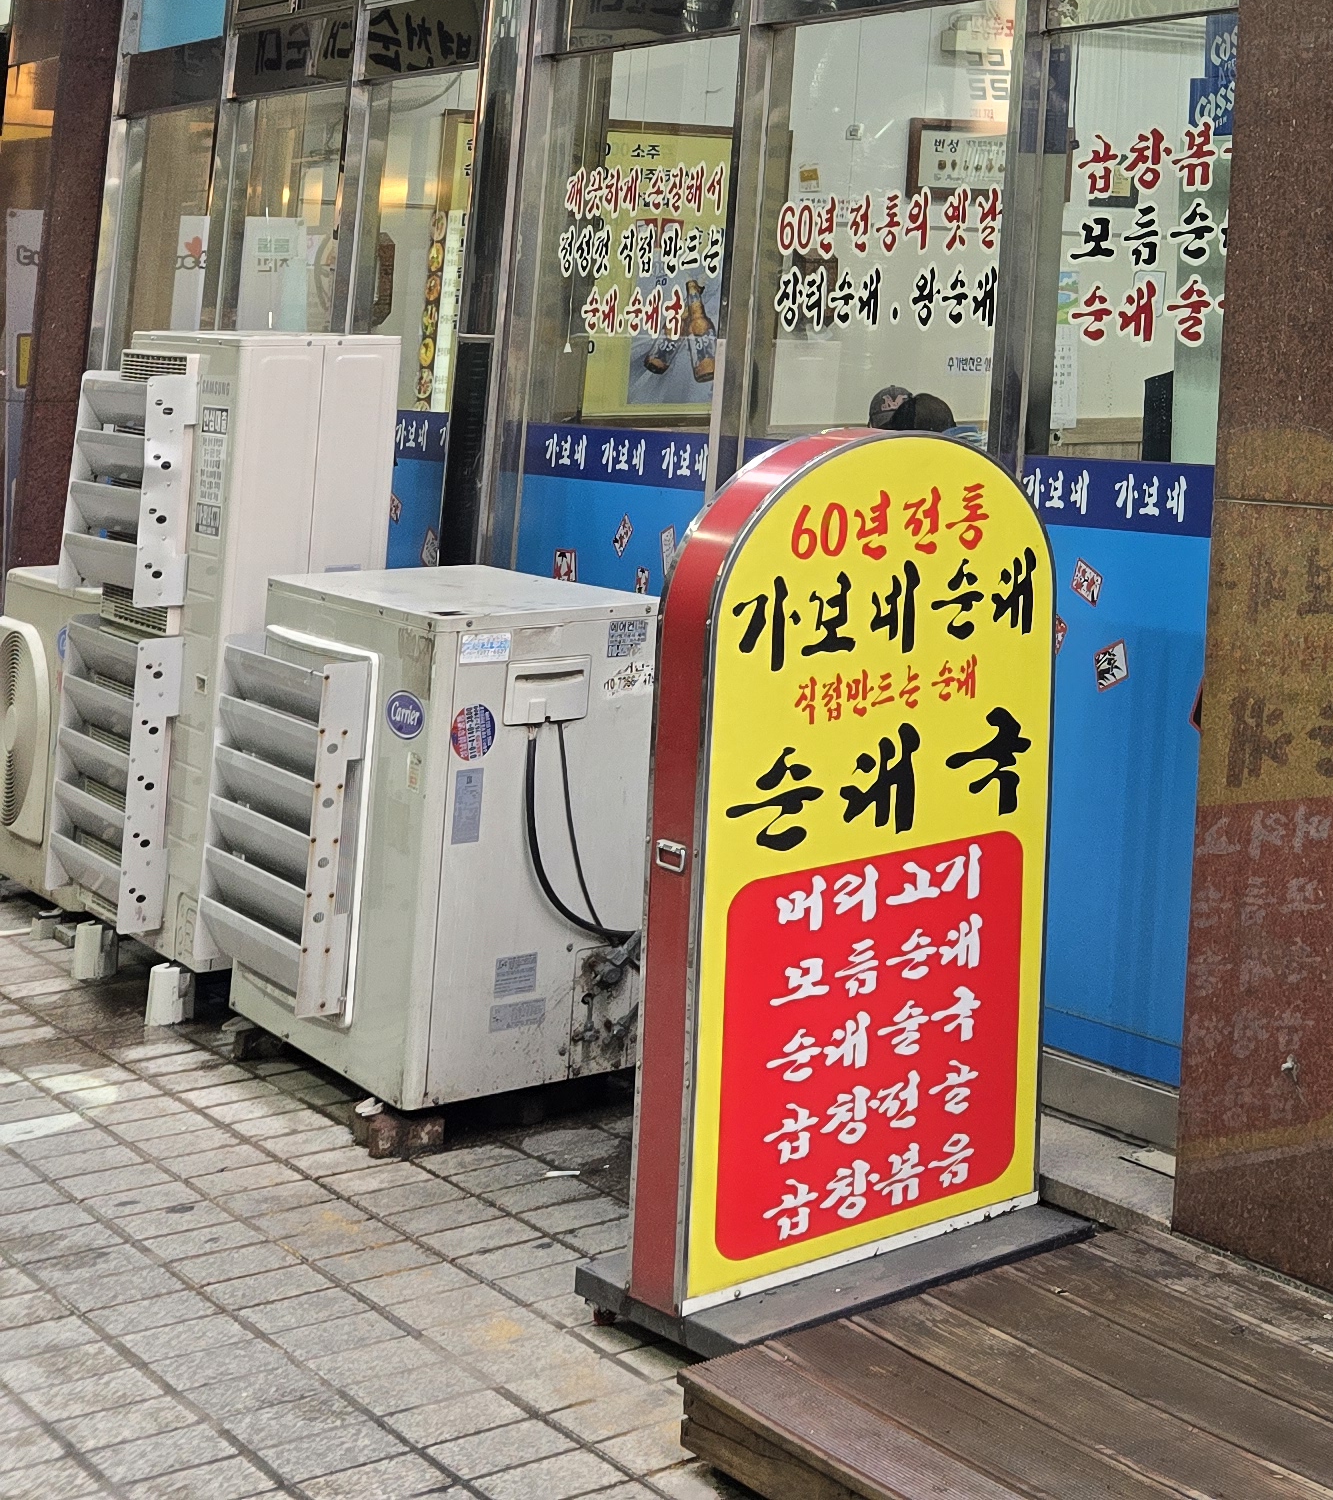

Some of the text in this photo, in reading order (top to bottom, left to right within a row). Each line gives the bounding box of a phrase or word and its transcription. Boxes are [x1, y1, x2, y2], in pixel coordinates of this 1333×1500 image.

[566, 164, 725, 216] 깨끗하게 손질해서
[1078, 124, 1232, 194] 곱창볶
[662, 225, 720, 277] 만드는
[779, 196, 836, 255] 60년
[849, 189, 930, 253] 전통의
[1070, 202, 1228, 266] 모듬순
[912, 266, 997, 327] 왕순대
[1072, 279, 1226, 342] 순대술
[202, 379, 231, 397] SAMSUNG
[395, 418, 429, 451] 가보네
[545, 433, 587, 470] 가보네
[601, 438, 646, 476] 가보네
[1023, 467, 1187, 522] 가보네 가보네
[930, 654, 977, 699] 순대
[390, 702, 421, 726] Carrier
[725, 706, 1032, 852] 순대국
[775, 843, 981, 930] 머리고기
[769, 913, 983, 1006] 모듬순대
[766, 986, 981, 1081] 순대술국
[763, 1059, 979, 1164] 곱창전골
[762, 1132, 975, 1240] 곱창볶음
